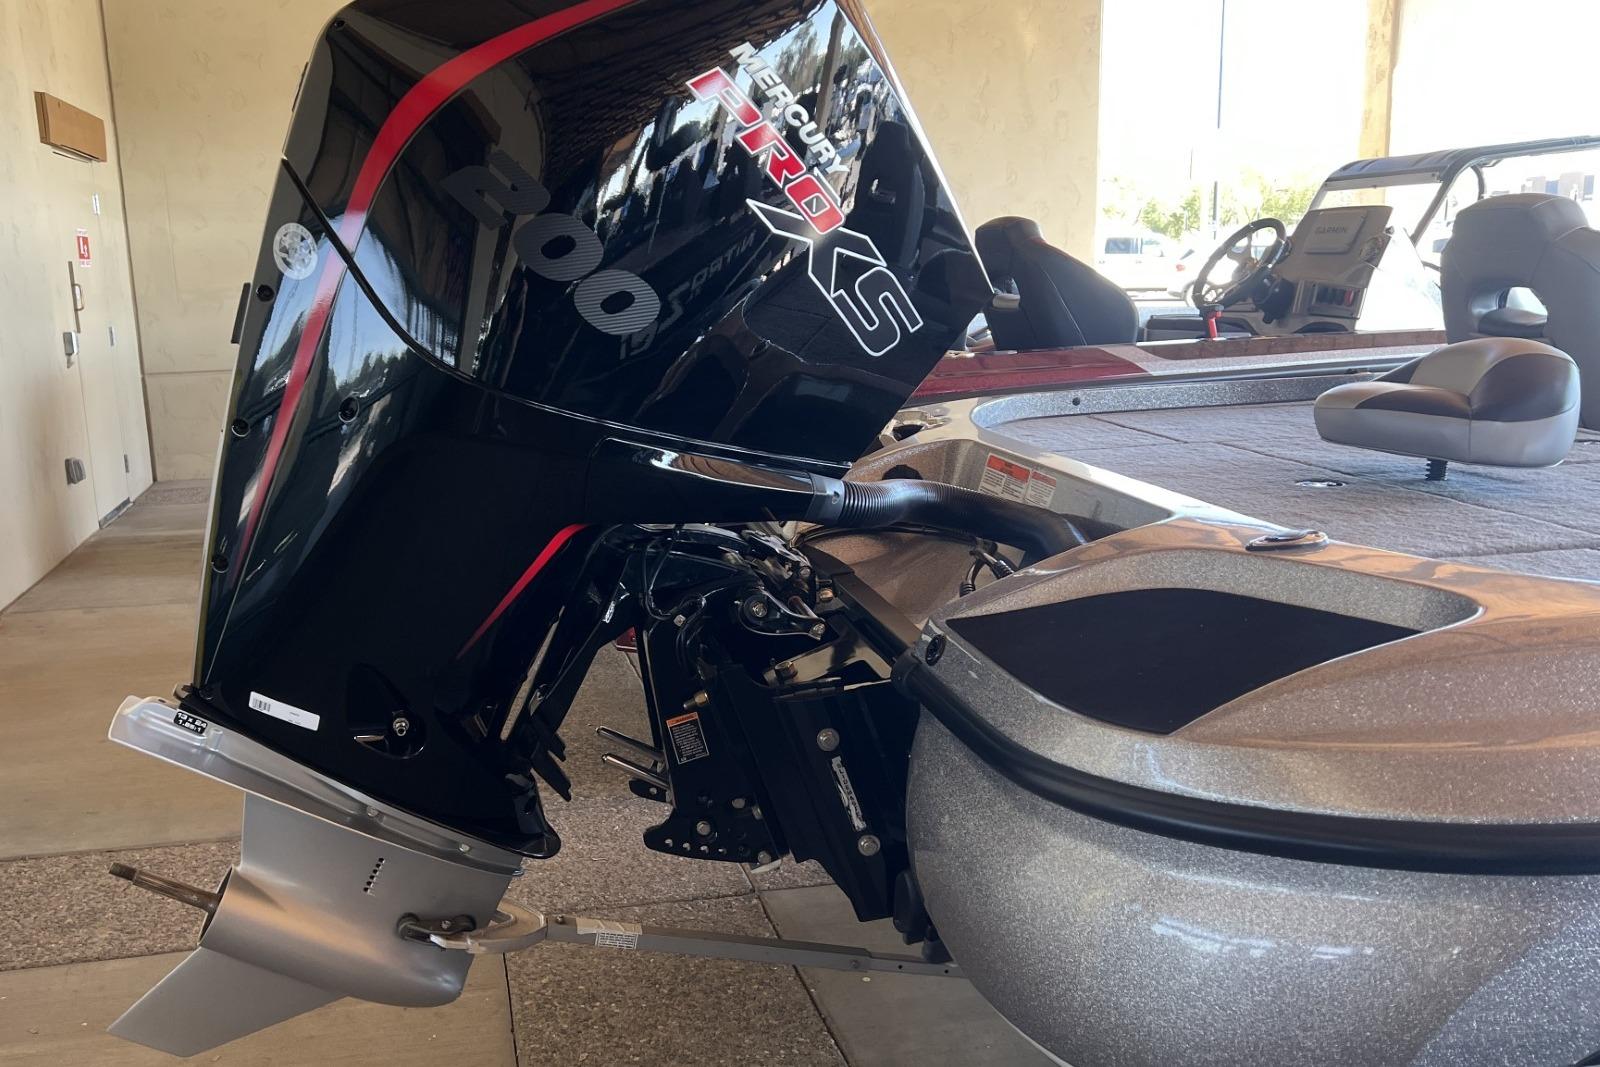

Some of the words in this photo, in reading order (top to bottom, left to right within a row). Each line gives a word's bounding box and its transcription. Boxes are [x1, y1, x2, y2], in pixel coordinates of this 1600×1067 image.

[686, 66, 845, 235] PRO
[729, 42, 850, 173] MERCURY
[437, 149, 661, 336] 200
[745, 168, 924, 357] XS
